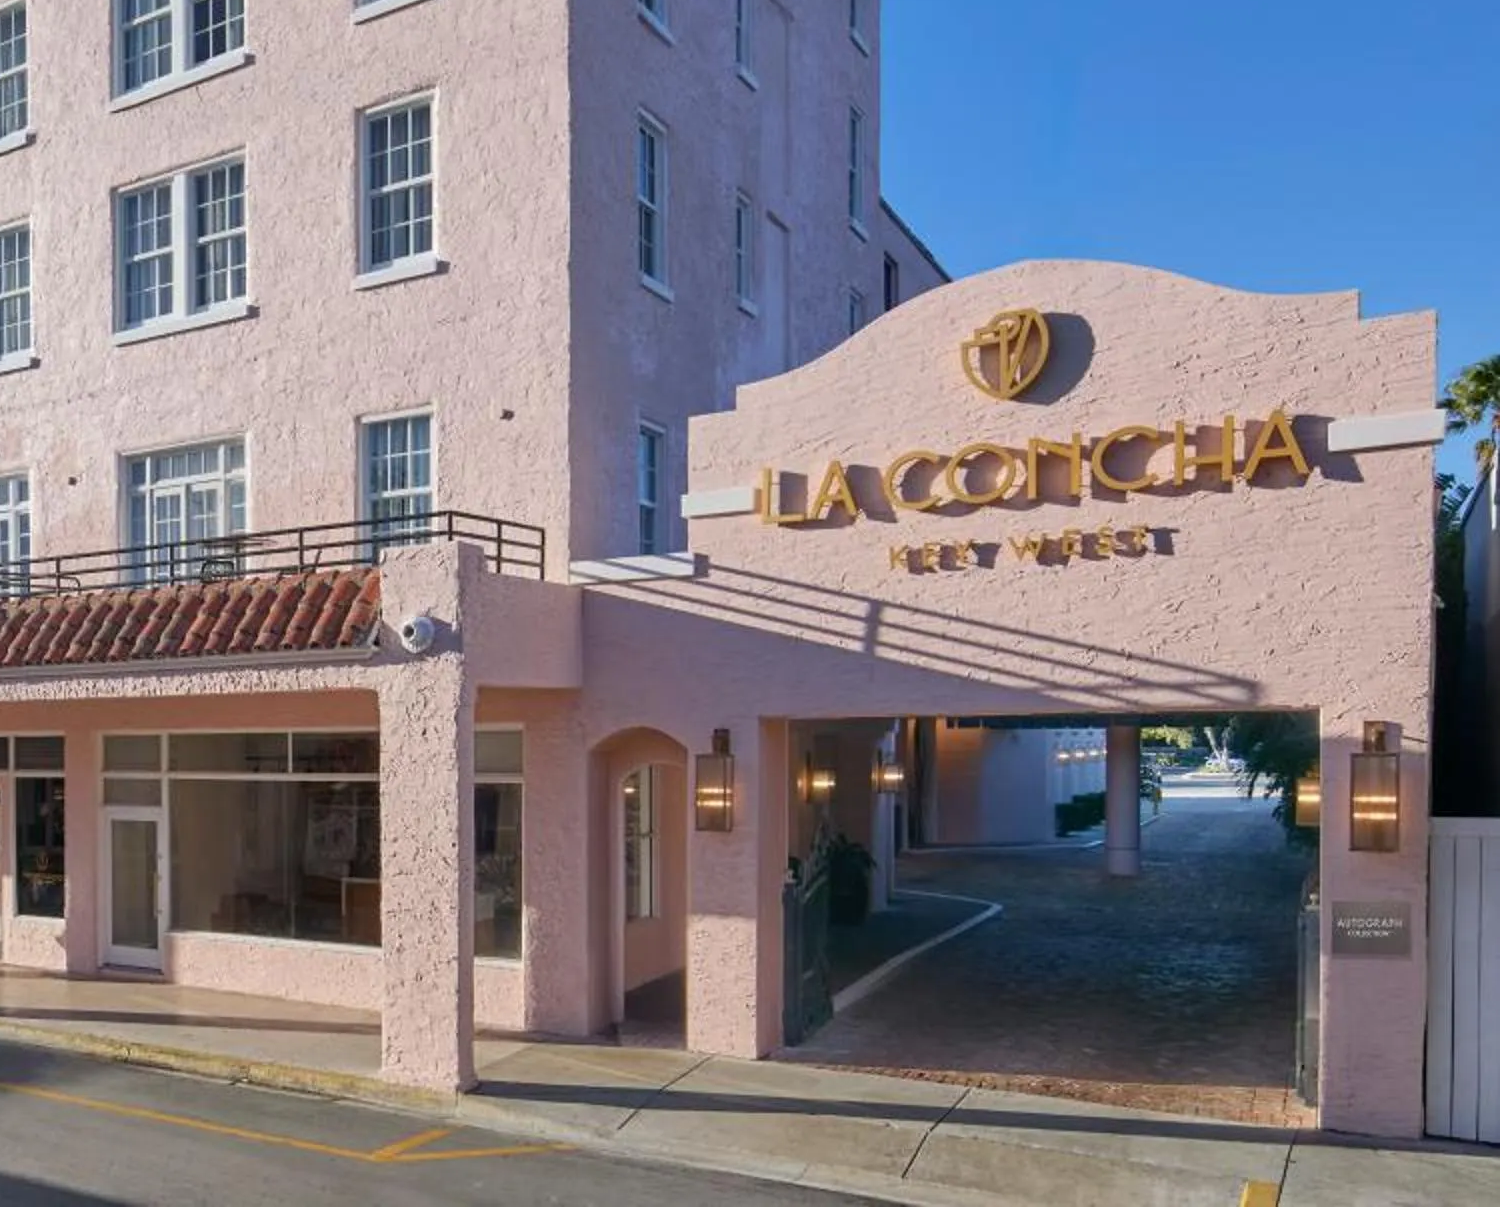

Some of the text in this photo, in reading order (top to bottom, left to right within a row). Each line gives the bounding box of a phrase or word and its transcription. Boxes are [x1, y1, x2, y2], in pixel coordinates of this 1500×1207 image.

[760, 408, 1312, 525] LA CONCHA
[889, 524, 1150, 571] KEY WEST
[1336, 917, 1403, 929] AUTOGRAPH
